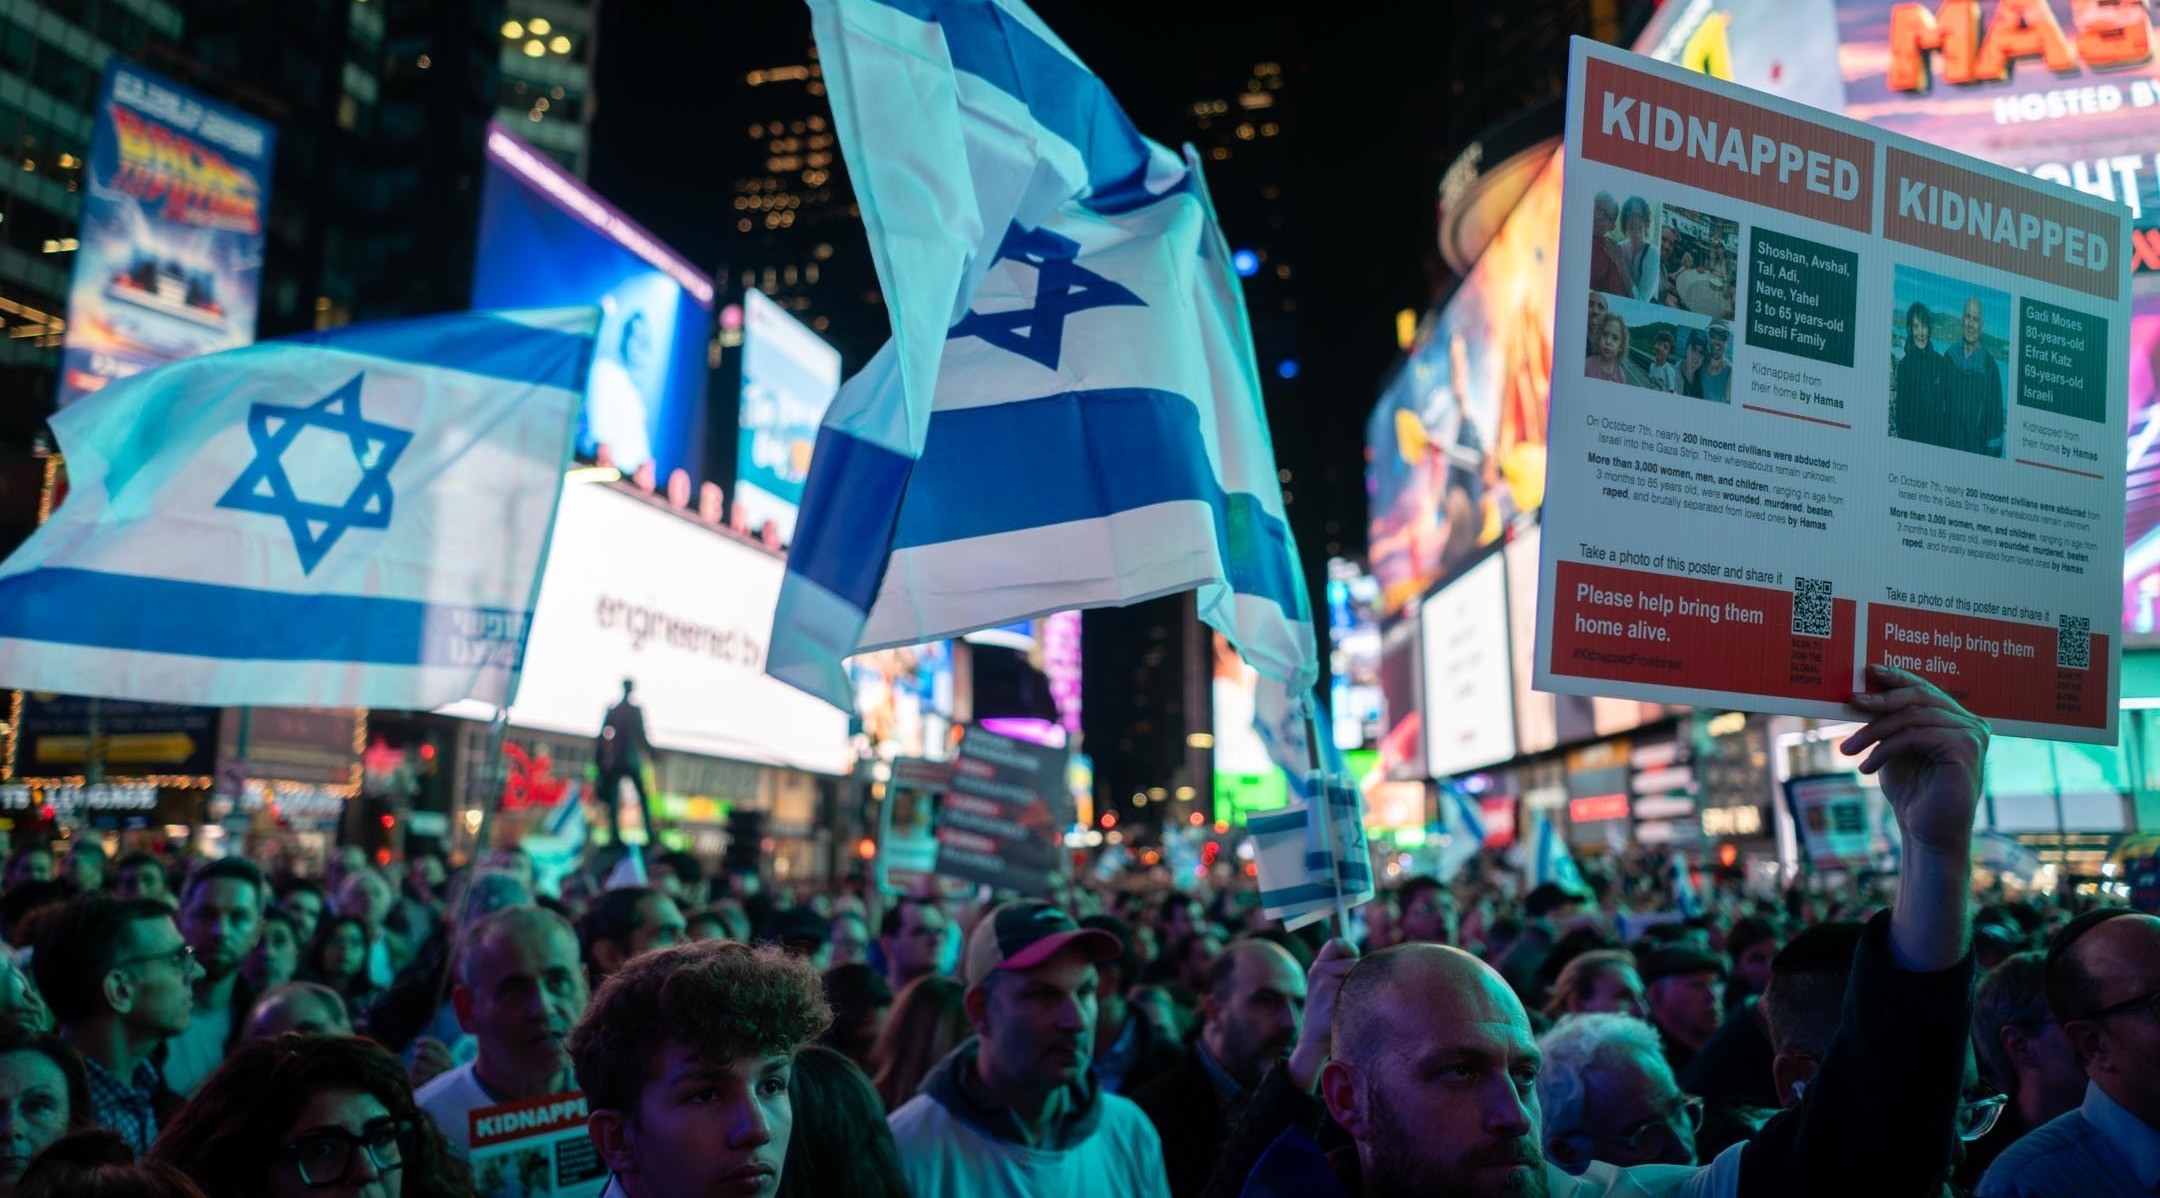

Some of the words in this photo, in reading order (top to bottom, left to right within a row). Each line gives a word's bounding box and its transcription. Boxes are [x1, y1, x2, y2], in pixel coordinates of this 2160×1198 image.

[1994, 84, 2122, 124] HOSTED
[1602, 91, 1859, 200] KIDNAPPED
[1899, 177, 2108, 271] KIDNAPPED
[1757, 260, 1775, 278] Tal,
[1777, 266, 1799, 284] Adi,
[1758, 241, 1808, 267] Shoshan,
[1811, 255, 1849, 277] Avshal,
[1756, 280, 1786, 300] Nave,
[1789, 288, 1818, 306] Yahel
[1755, 300, 1761, 313] 3
[1764, 303, 1775, 316] to
[1778, 305, 1791, 320] 65
[1794, 312, 1843, 332] years-old
[2026, 306, 2048, 322] Gadi
[2051, 312, 2082, 331] Moses
[1754, 319, 1787, 339] Israeli
[1790, 328, 1826, 350] Family
[2025, 325, 2084, 351] 80-years-old
[2025, 344, 2048, 361] Efrat
[2051, 350, 2072, 367] Katz
[1752, 362, 1800, 382] Kidnapped
[1802, 372, 1821, 386] from
[2024, 364, 2083, 389] 69-years-old
[1751, 380, 1770, 393] their
[1773, 384, 1797, 399] home
[1799, 389, 1811, 404] by
[1813, 392, 1844, 408] Hamas
[2023, 384, 2053, 402] Israeli
[1586, 414, 1599, 426] On
[1601, 417, 1636, 432] October
[1655, 429, 1680, 443] nearly
[1682, 432, 1697, 444] 200
[1699, 435, 1736, 451] innocent
[1737, 443, 1771, 458] civilians
[1773, 451, 1792, 461] were
[1794, 454, 1830, 468] abducted
[1832, 460, 1848, 471] from
[1598, 432, 1621, 445] Israel
[1623, 438, 1639, 449] into
[1641, 440, 1654, 451] the
[1656, 442, 1678, 456] Gaza
[1702, 450, 1722, 462] Their
[1724, 456, 1773, 473] whereabouts
[1775, 465, 1800, 476] remain
[1587, 452, 1610, 465] More
[1612, 456, 1632, 468] than
[1634, 460, 1658, 473] 3,000
[1718, 476, 1733, 486] and
[1772, 486, 1801, 500] ranging
[1803, 491, 1810, 499] in
[1811, 492, 1826, 503] age
[1827, 492, 1843, 504] from
[1596, 468, 1602, 479] 3
[1604, 472, 1635, 484] months
[1637, 476, 1645, 486] to
[1647, 477, 1657, 488] 85
[1660, 481, 1682, 492] years
[1701, 488, 1720, 499] were
[1632, 492, 1649, 502] and
[1651, 493, 1681, 509] brutally
[1683, 500, 1723, 514] separated
[1725, 504, 1742, 516] from
[1744, 508, 1765, 521] loved
[1767, 513, 1786, 524] ones
[1787, 515, 1797, 528] by
[1579, 542, 1606, 560] Take
[1608, 550, 1616, 561] a
[1619, 550, 1650, 566] photo
[1653, 554, 1664, 567] of
[1666, 556, 1685, 571] this
[1687, 562, 1721, 575] poster
[1723, 566, 1742, 579] and
[1745, 568, 1773, 583] share
[1776, 571, 1782, 584] it
[1577, 583, 1633, 608] Please
[1638, 590, 1673, 617] help
[1678, 596, 1720, 623] bring
[1724, 602, 1763, 624] them
[1885, 586, 1907, 602] Take
[1909, 593, 1915, 603] a
[1917, 592, 1942, 607] photo
[1944, 596, 1954, 608] of
[1955, 597, 1971, 611] this
[1972, 602, 2000, 614] poster
[2001, 605, 2017, 617] and
[2019, 607, 2042, 621] share
[2044, 610, 2049, 622] it
[1575, 612, 1622, 636] home
[1627, 620, 1672, 641] alive.
[1884, 622, 1929, 644] Please
[1933, 628, 1962, 652] help
[1965, 633, 1999, 657] bring
[2002, 638, 2034, 657] them
[1884, 649, 1921, 671] home
[1925, 655, 1959, 675] alive.
[46, 784, 157, 810] LUGAGE
[476, 1097, 588, 1138] KIDNAPPE
